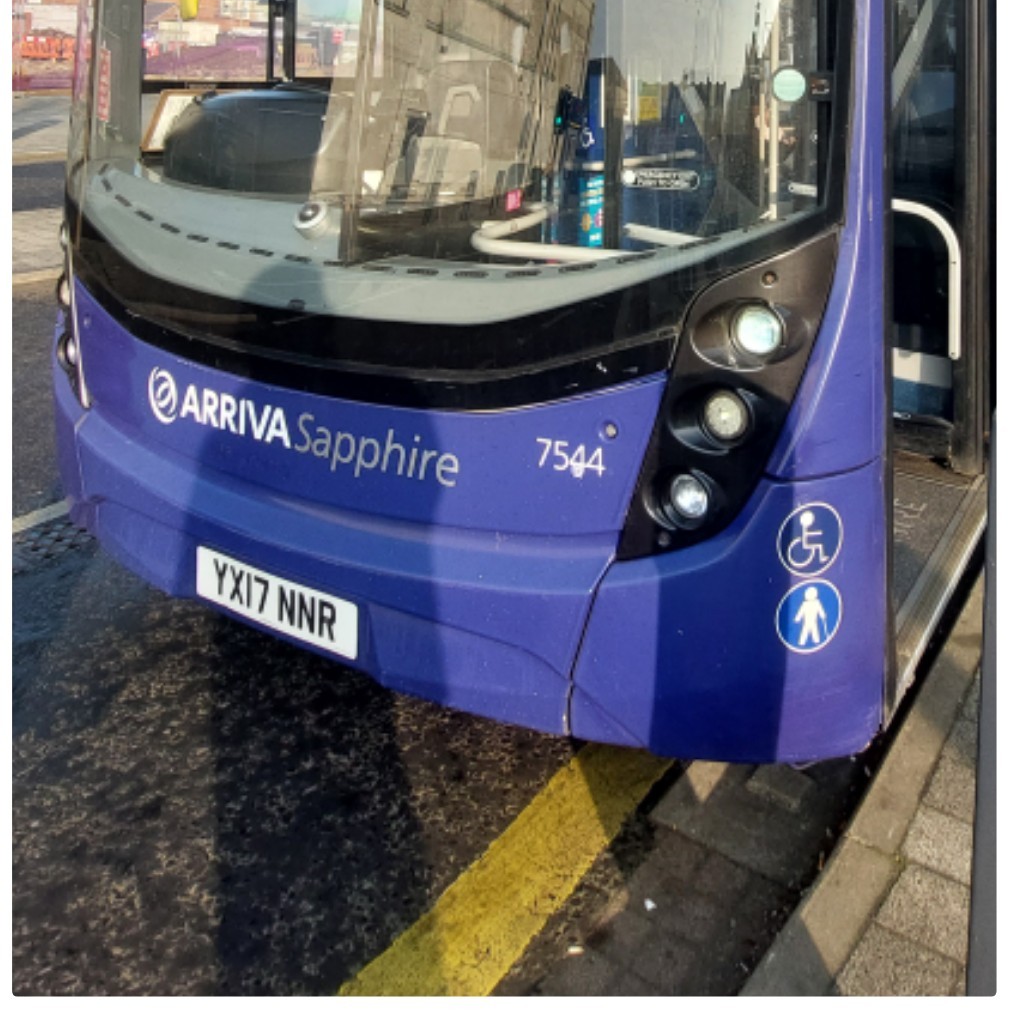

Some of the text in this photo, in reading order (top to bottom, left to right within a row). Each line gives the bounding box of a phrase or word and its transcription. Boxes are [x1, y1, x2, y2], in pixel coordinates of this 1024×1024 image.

[180, 384, 461, 488] ARRIVA Sapphire
[535, 437, 606, 477] 7544
[213, 558, 337, 642] YX17 NNR
